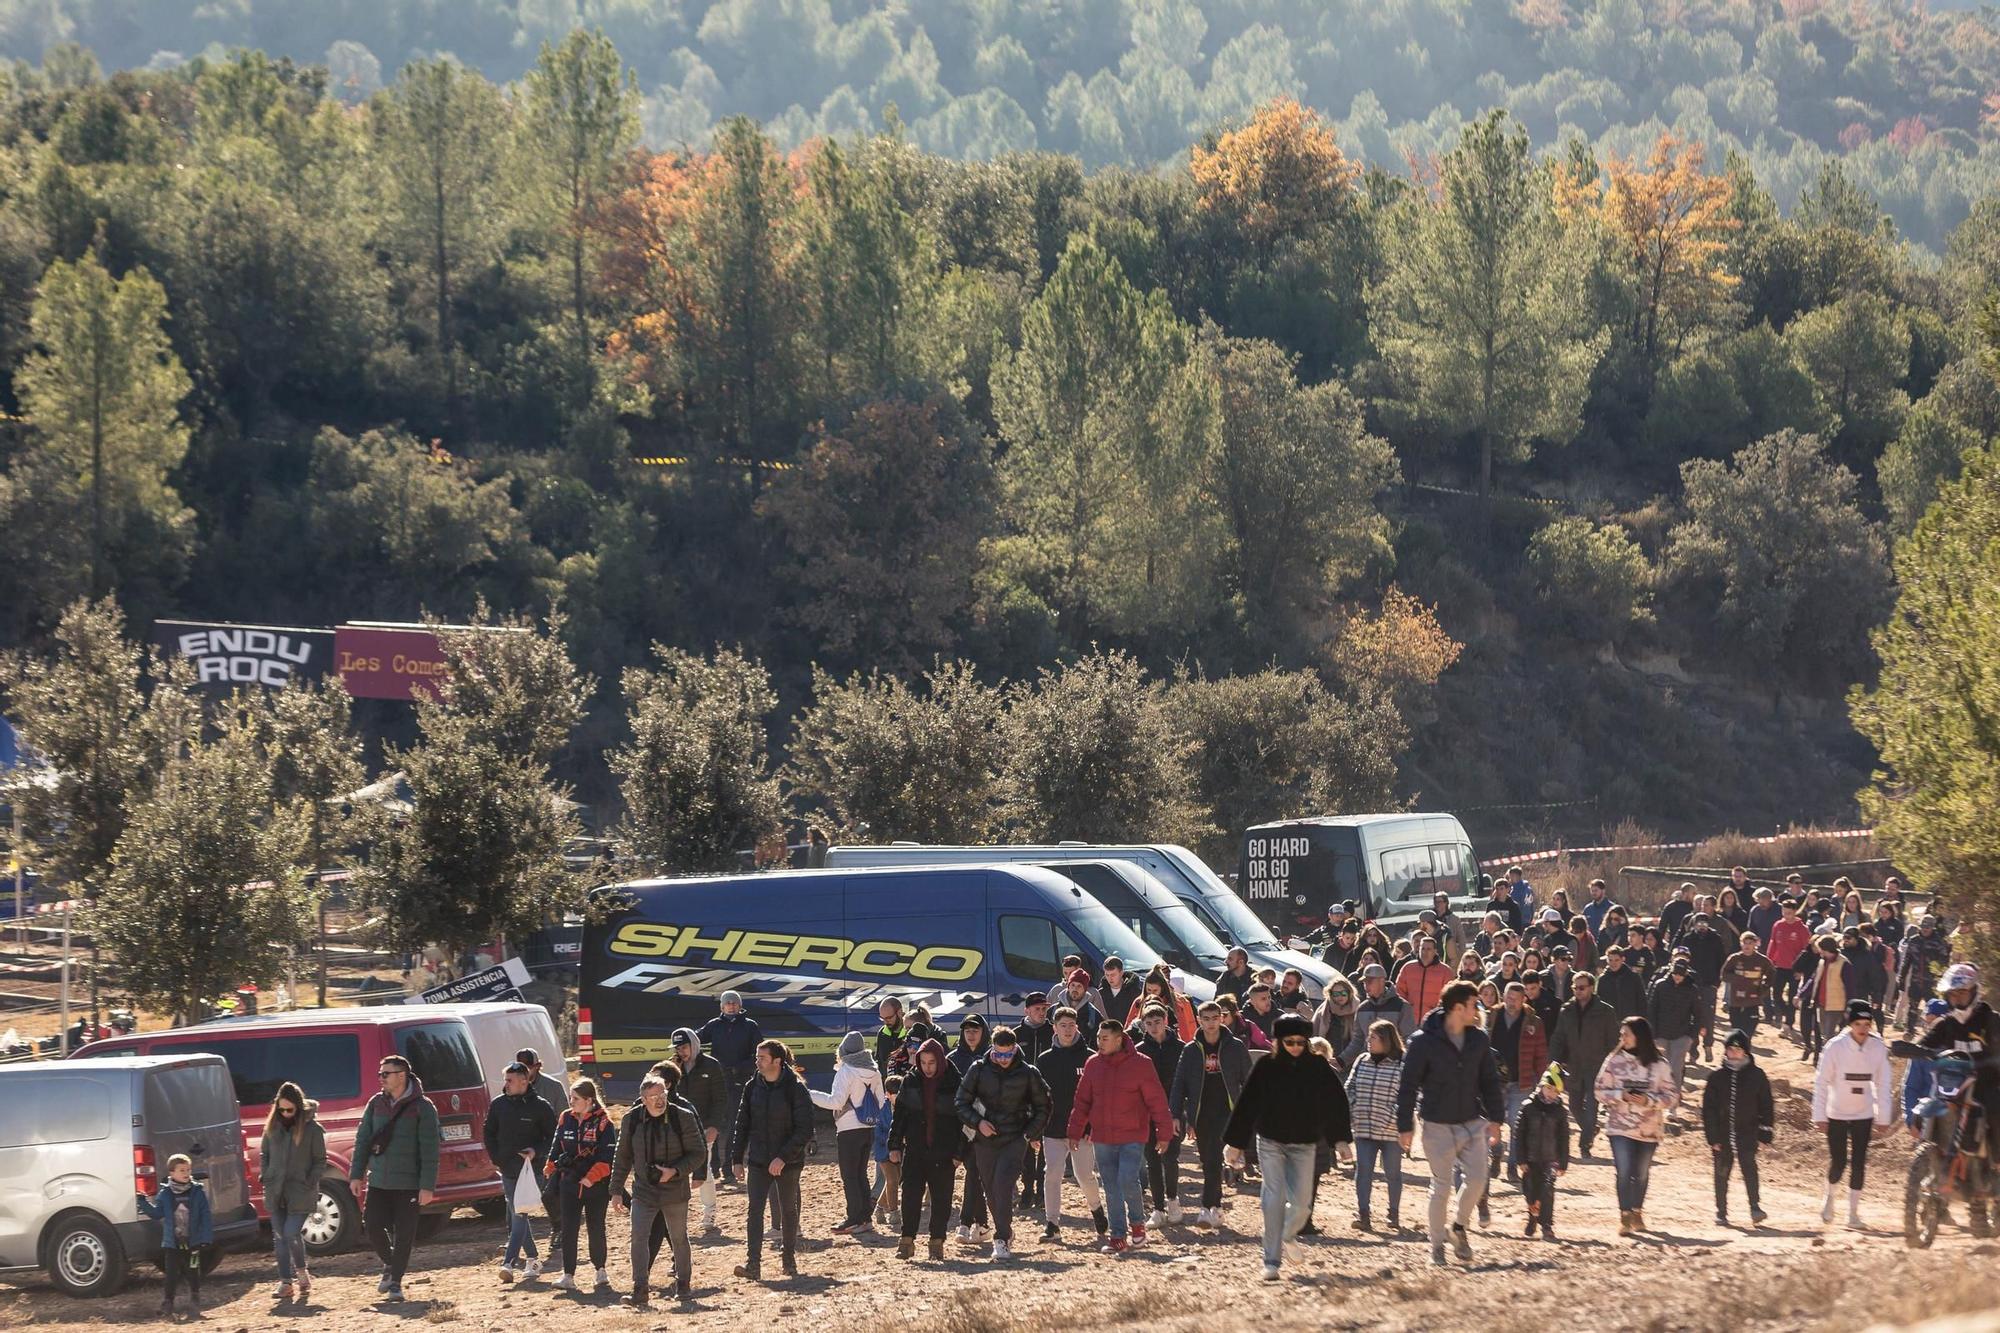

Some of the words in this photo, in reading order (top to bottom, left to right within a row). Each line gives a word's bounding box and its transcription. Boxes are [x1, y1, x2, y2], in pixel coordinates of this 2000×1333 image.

[179, 630, 311, 664] ENDU
[199, 656, 291, 687] ROC
[340, 652, 381, 672] Les
[392, 655, 451, 676] Come
[1248, 839, 1267, 858] GO
[1270, 838, 1310, 857] HARD
[1249, 860, 1268, 878] OR
[1270, 859, 1290, 878] GO
[1249, 879, 1290, 899] HOME
[609, 923, 984, 981] SHERCO
[451, 969, 506, 993] ASSISTENCIA
